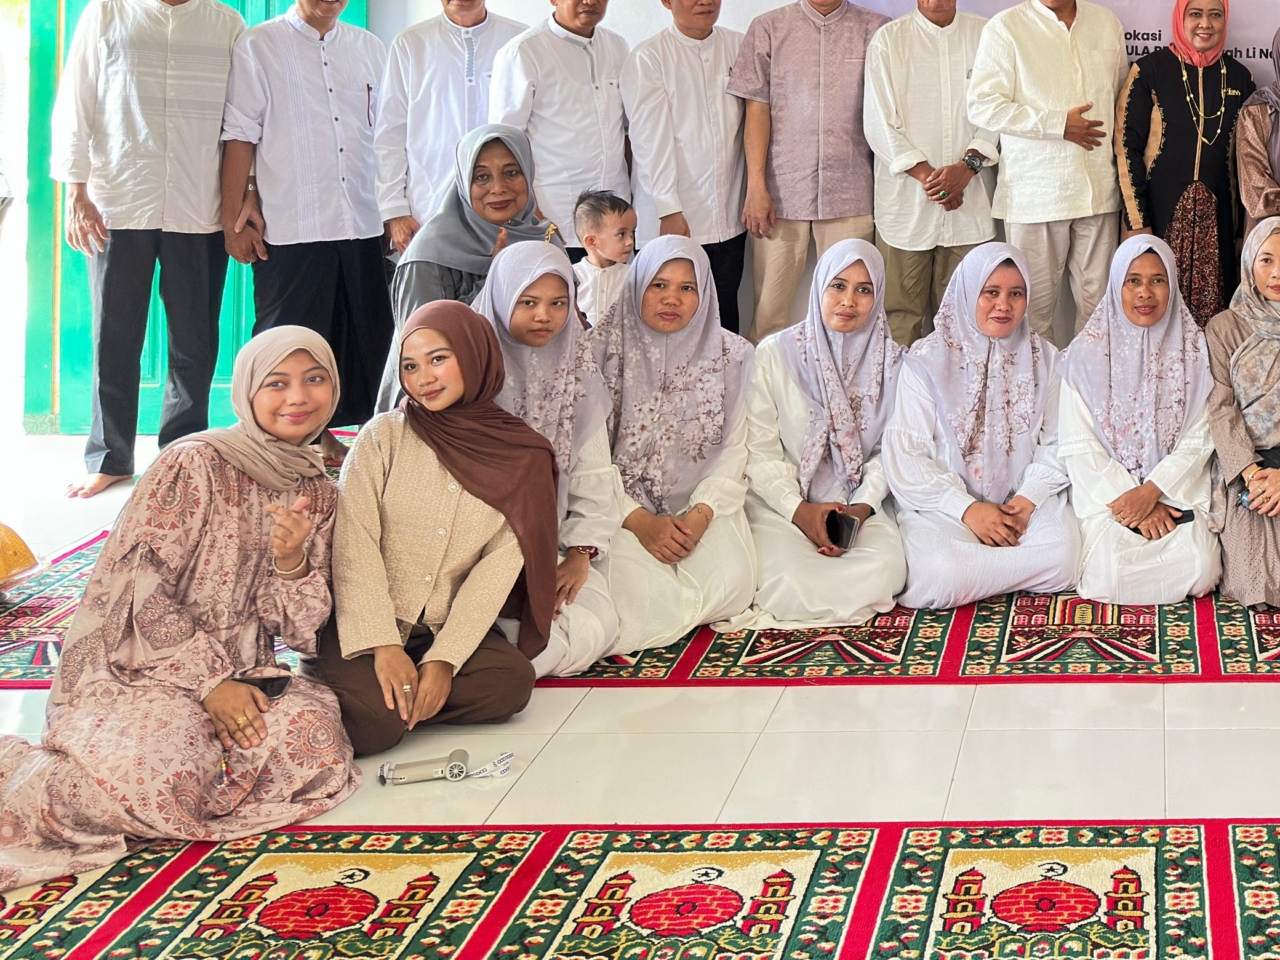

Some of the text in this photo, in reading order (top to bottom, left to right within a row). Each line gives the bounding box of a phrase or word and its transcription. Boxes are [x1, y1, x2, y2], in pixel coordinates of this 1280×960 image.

[1124, 29, 1162, 41] okasi
[1125, 44, 1150, 56] ULA
[1246, 46, 1256, 59] Li
